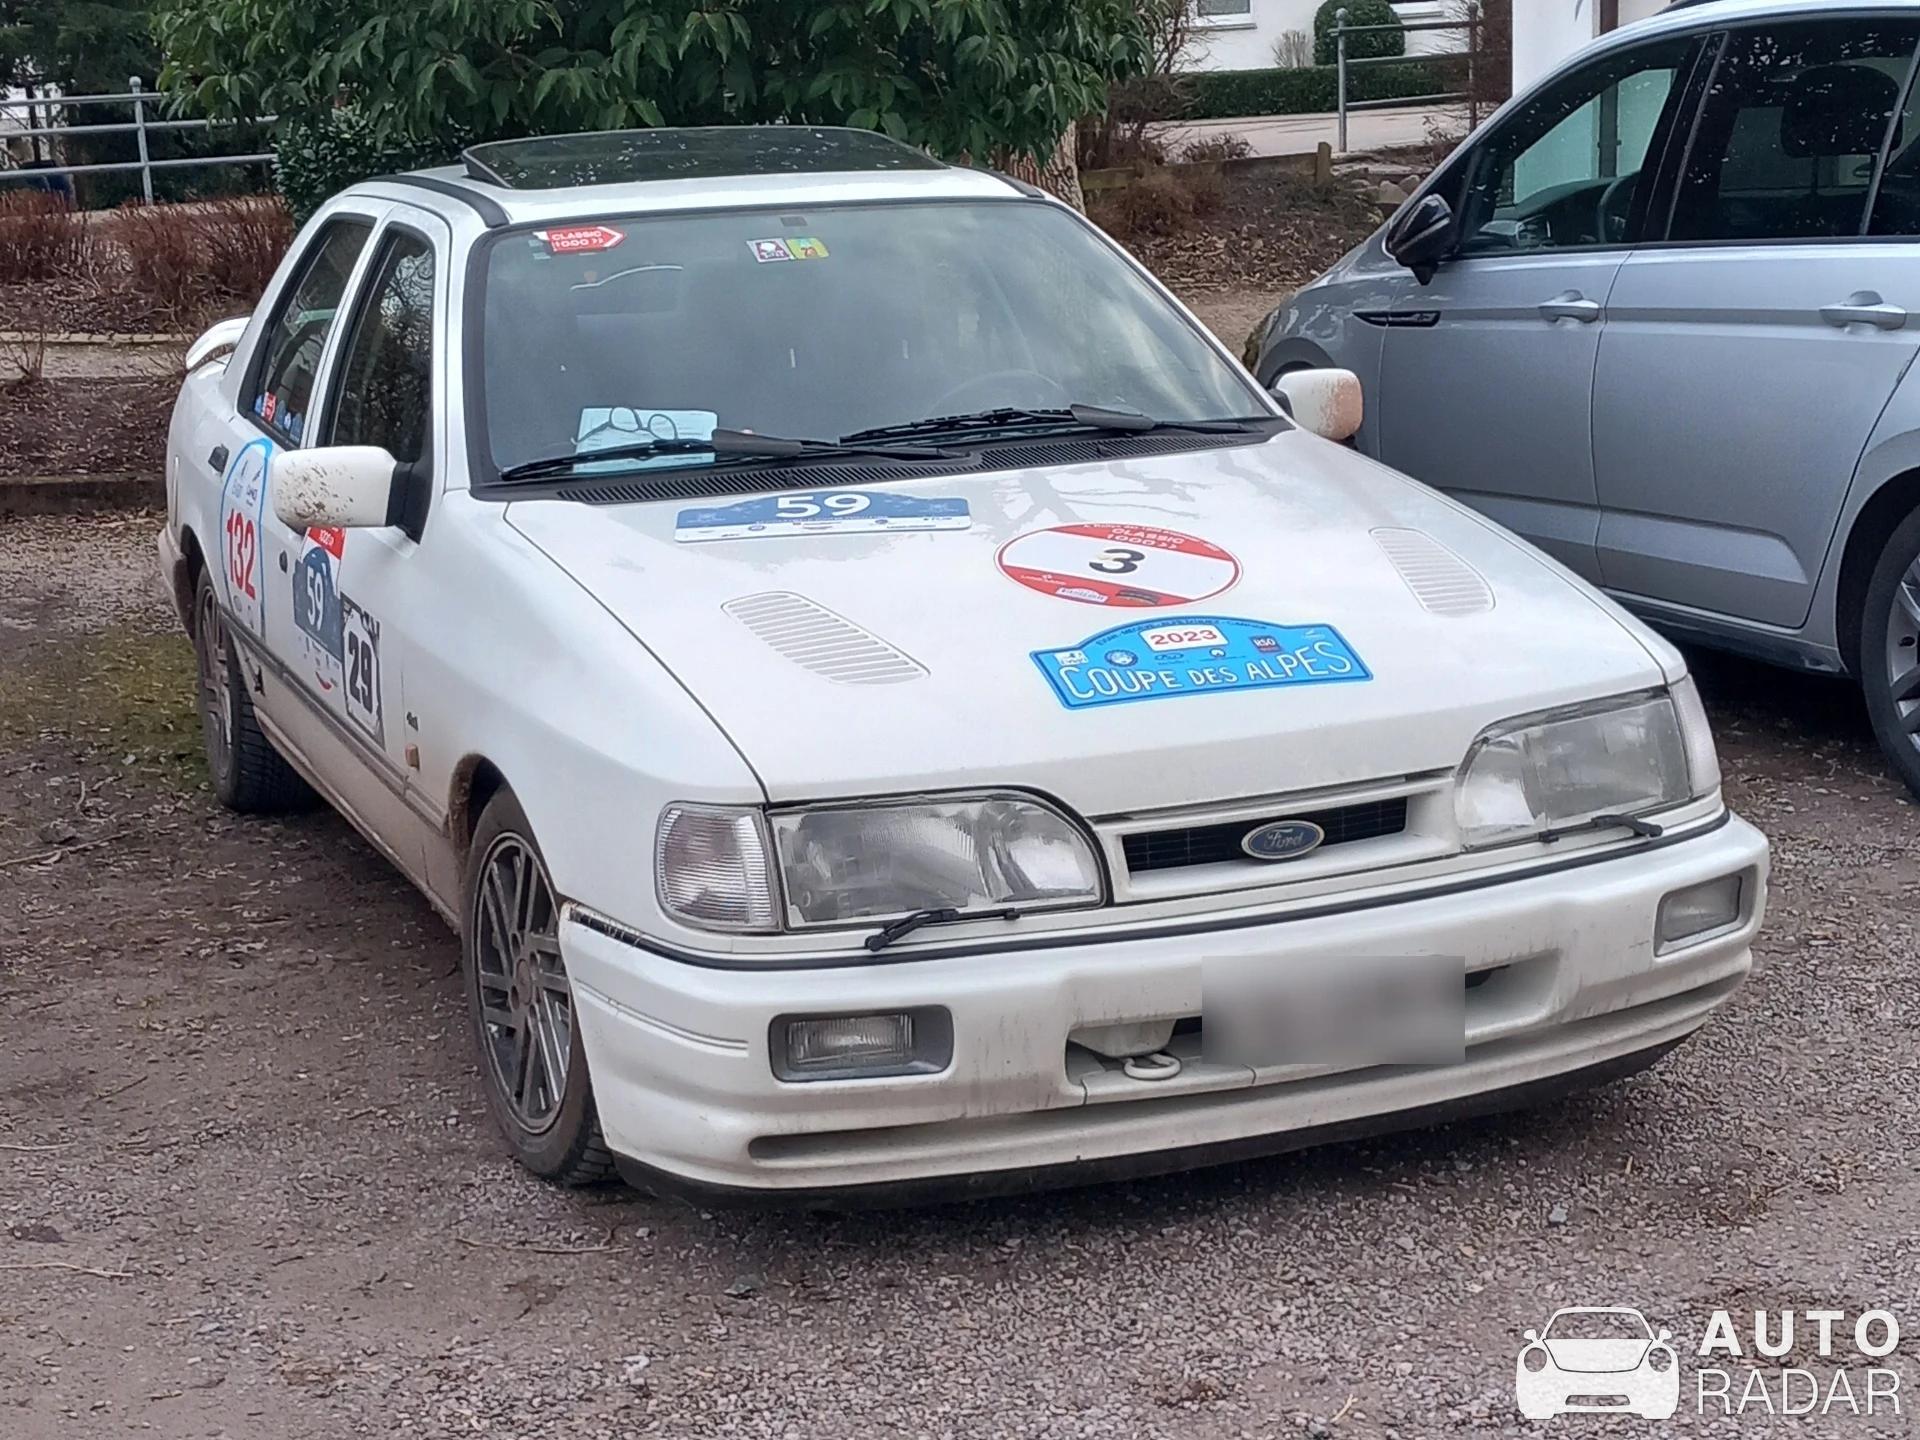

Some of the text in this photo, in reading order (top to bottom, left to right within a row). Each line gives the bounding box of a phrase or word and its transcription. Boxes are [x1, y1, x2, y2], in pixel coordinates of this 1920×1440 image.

[551, 230, 602, 241] CLASSIC
[775, 493, 871, 518] 59
[1111, 528, 1185, 544] CLASSIC
[226, 508, 256, 600] 132
[1089, 548, 1146, 575] 3
[306, 565, 325, 632] 59
[1150, 629, 1218, 645] 2023
[349, 630, 373, 715] 29
[1058, 640, 1352, 700] COUPE DES ALPES
[1263, 827, 1304, 851] Ford
